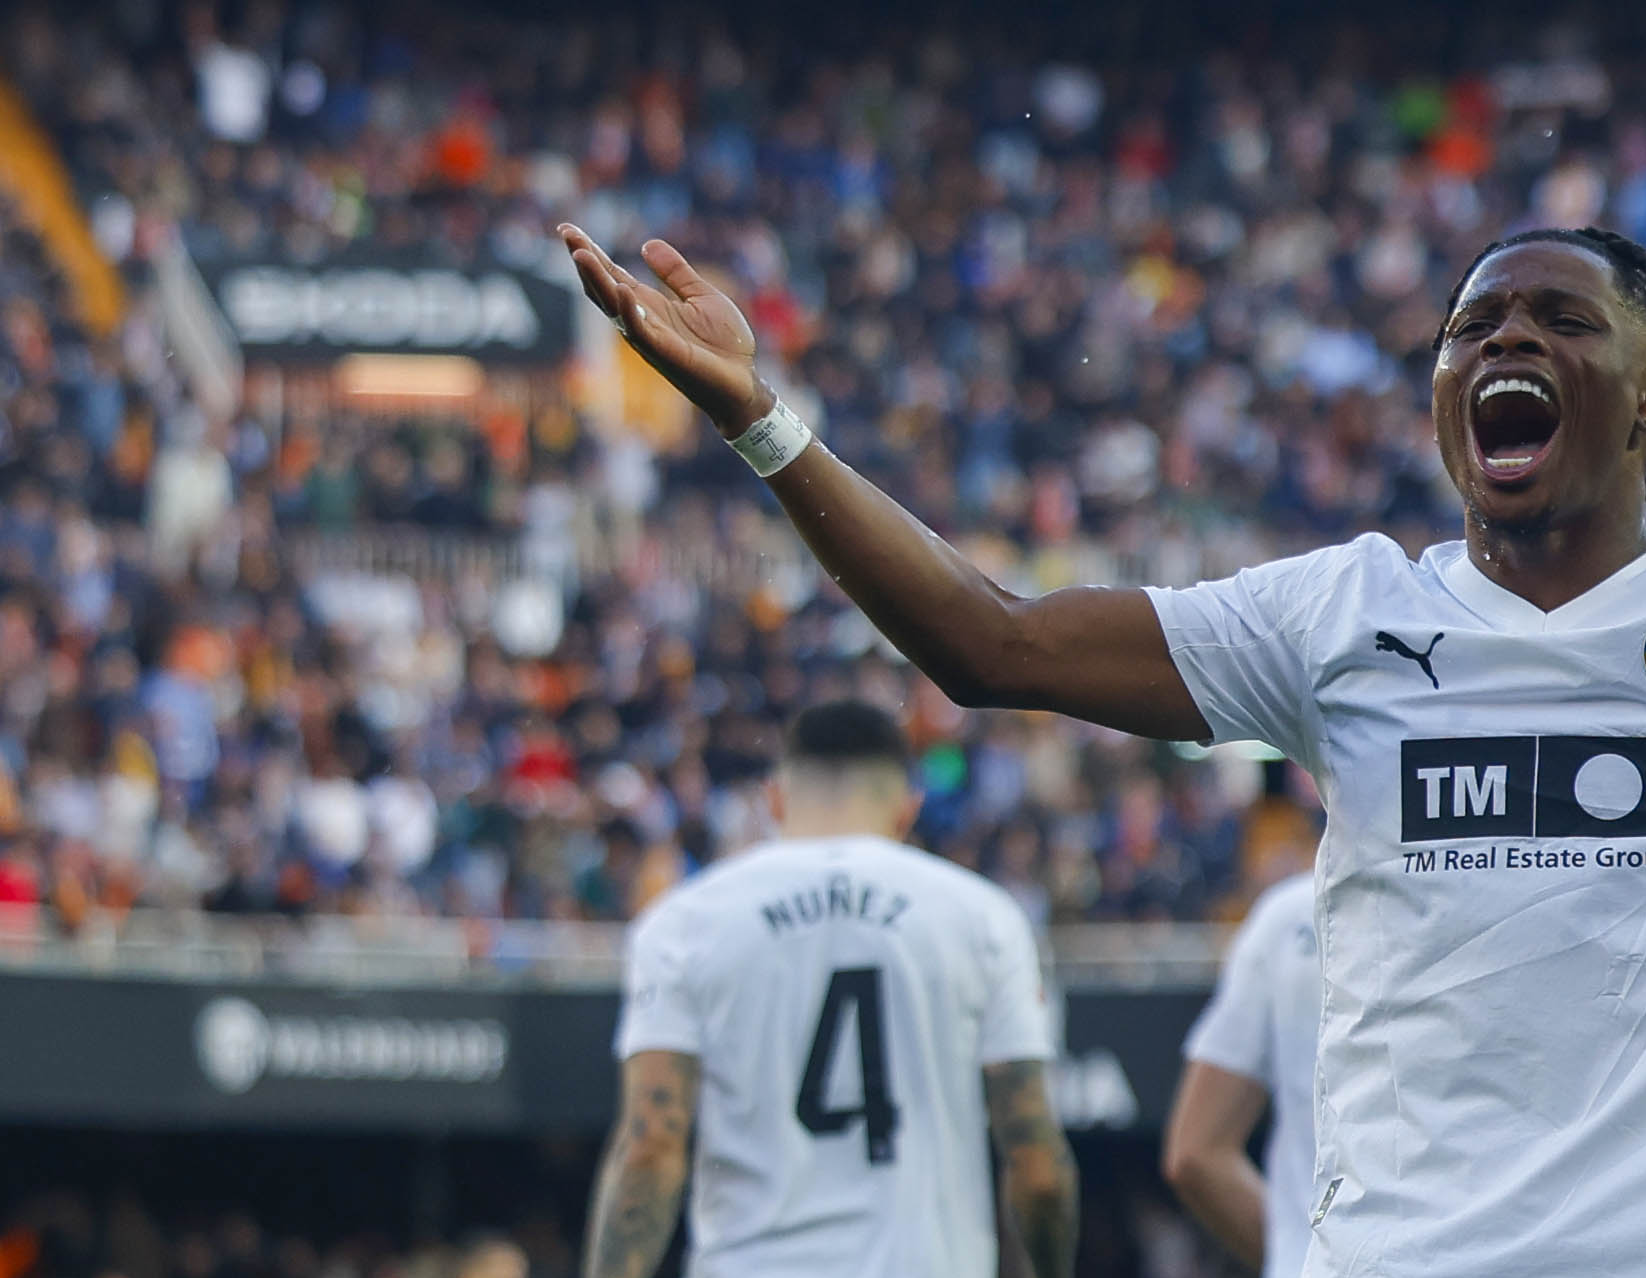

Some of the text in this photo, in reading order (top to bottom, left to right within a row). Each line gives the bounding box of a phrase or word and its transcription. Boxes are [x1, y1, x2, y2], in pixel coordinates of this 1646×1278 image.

[1416, 765, 1508, 819] TM
[1402, 852, 1436, 873] TM
[1444, 847, 1496, 870] Real
[1506, 848, 1586, 869] Estate
[795, 965, 898, 1164] 4
